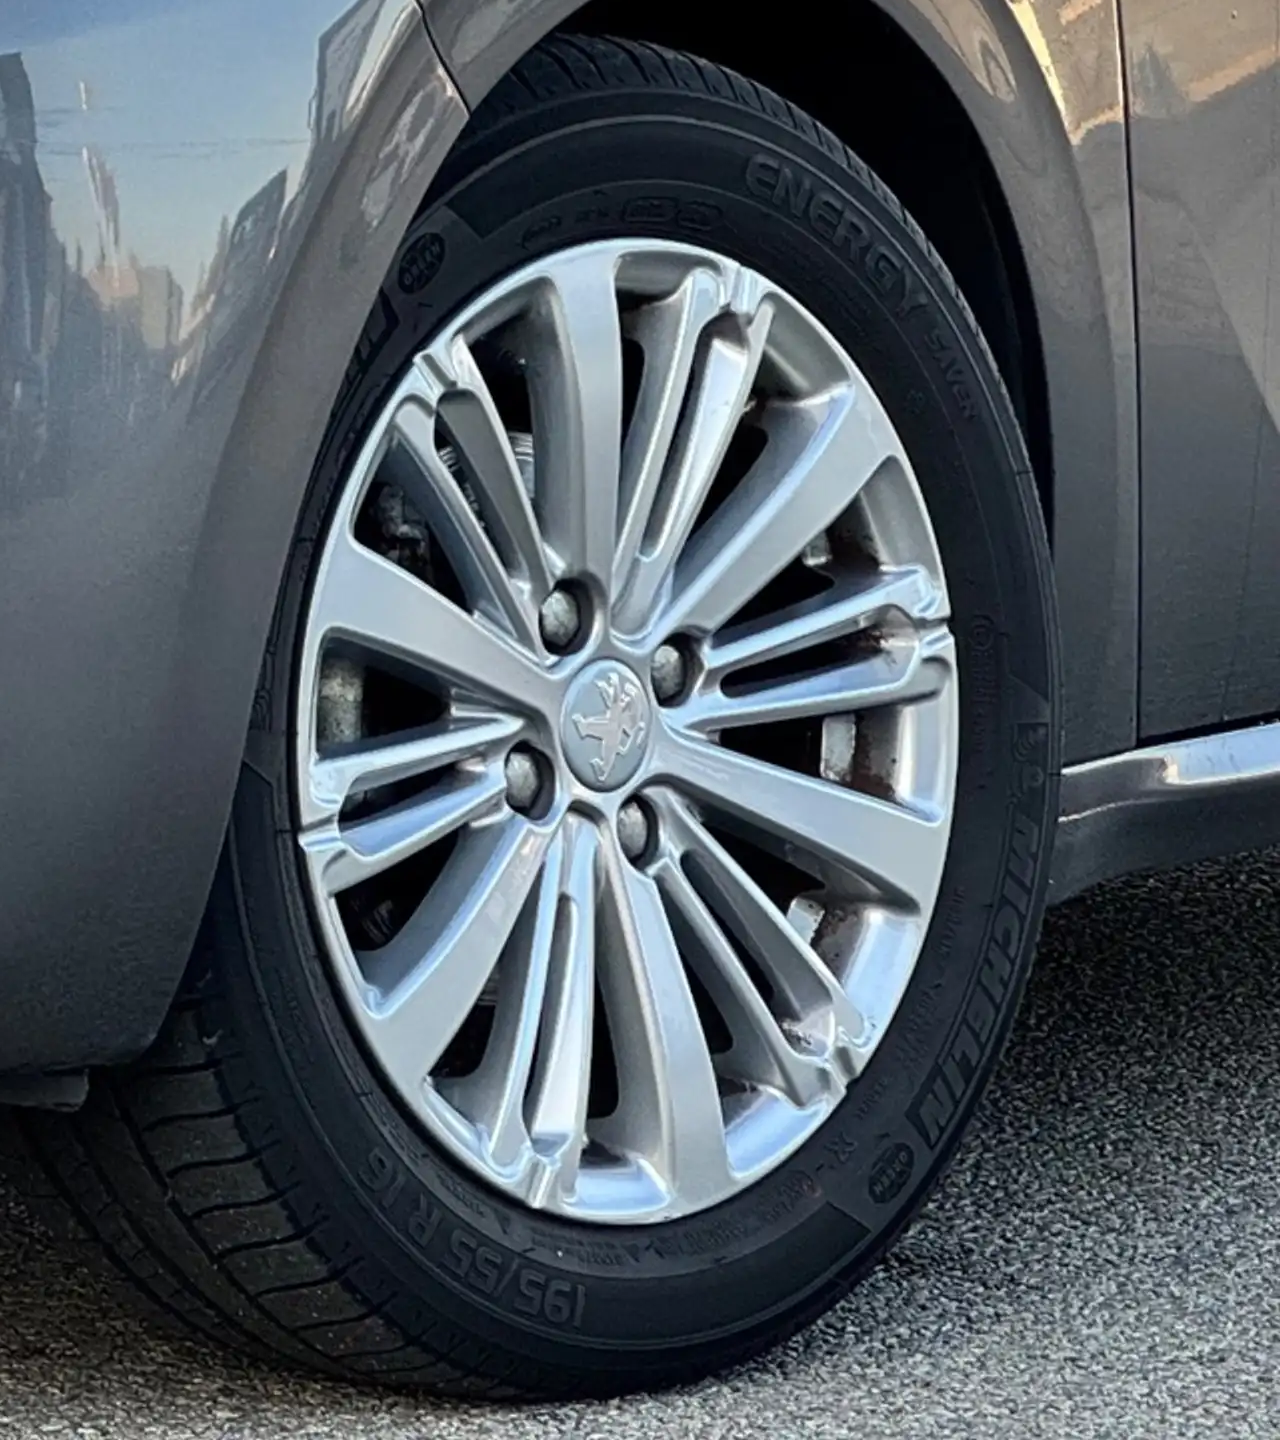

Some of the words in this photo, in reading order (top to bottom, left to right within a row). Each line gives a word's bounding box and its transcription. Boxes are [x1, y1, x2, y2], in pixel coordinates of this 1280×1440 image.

[745, 152, 930, 311] ENERGY
[918, 814, 1040, 1148] MICHELIN
[357, 1147, 408, 1209] 16
[407, 1192, 441, 1249] R
[442, 1227, 586, 1328] 195/55
